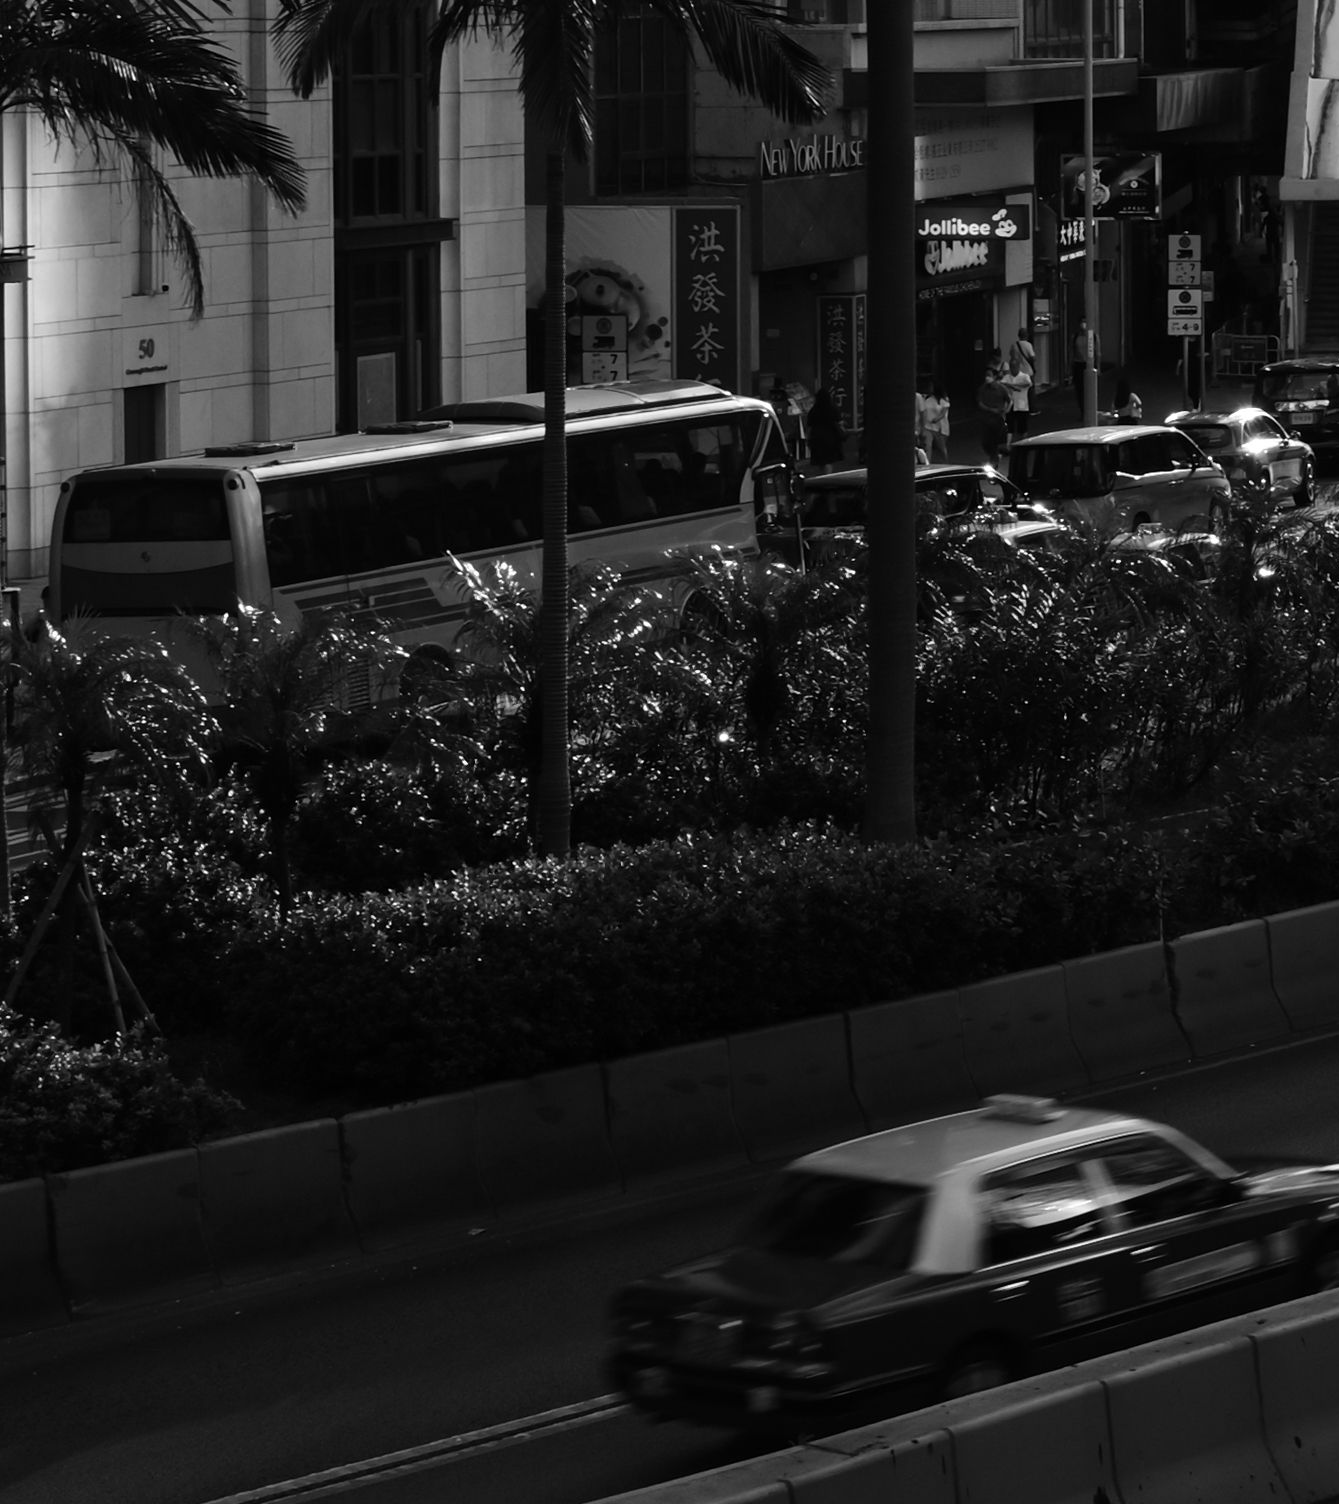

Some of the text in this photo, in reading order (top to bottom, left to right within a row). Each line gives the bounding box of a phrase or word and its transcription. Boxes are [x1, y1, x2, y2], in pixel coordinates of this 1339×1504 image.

[824, 134, 865, 169] HOUSE
[918, 217, 991, 236] Jollibee
[688, 221, 725, 385] 洪發茶
[138, 338, 155, 359] 50
[610, 354, 617, 364] 7
[827, 304, 847, 407] 洪發茶行
